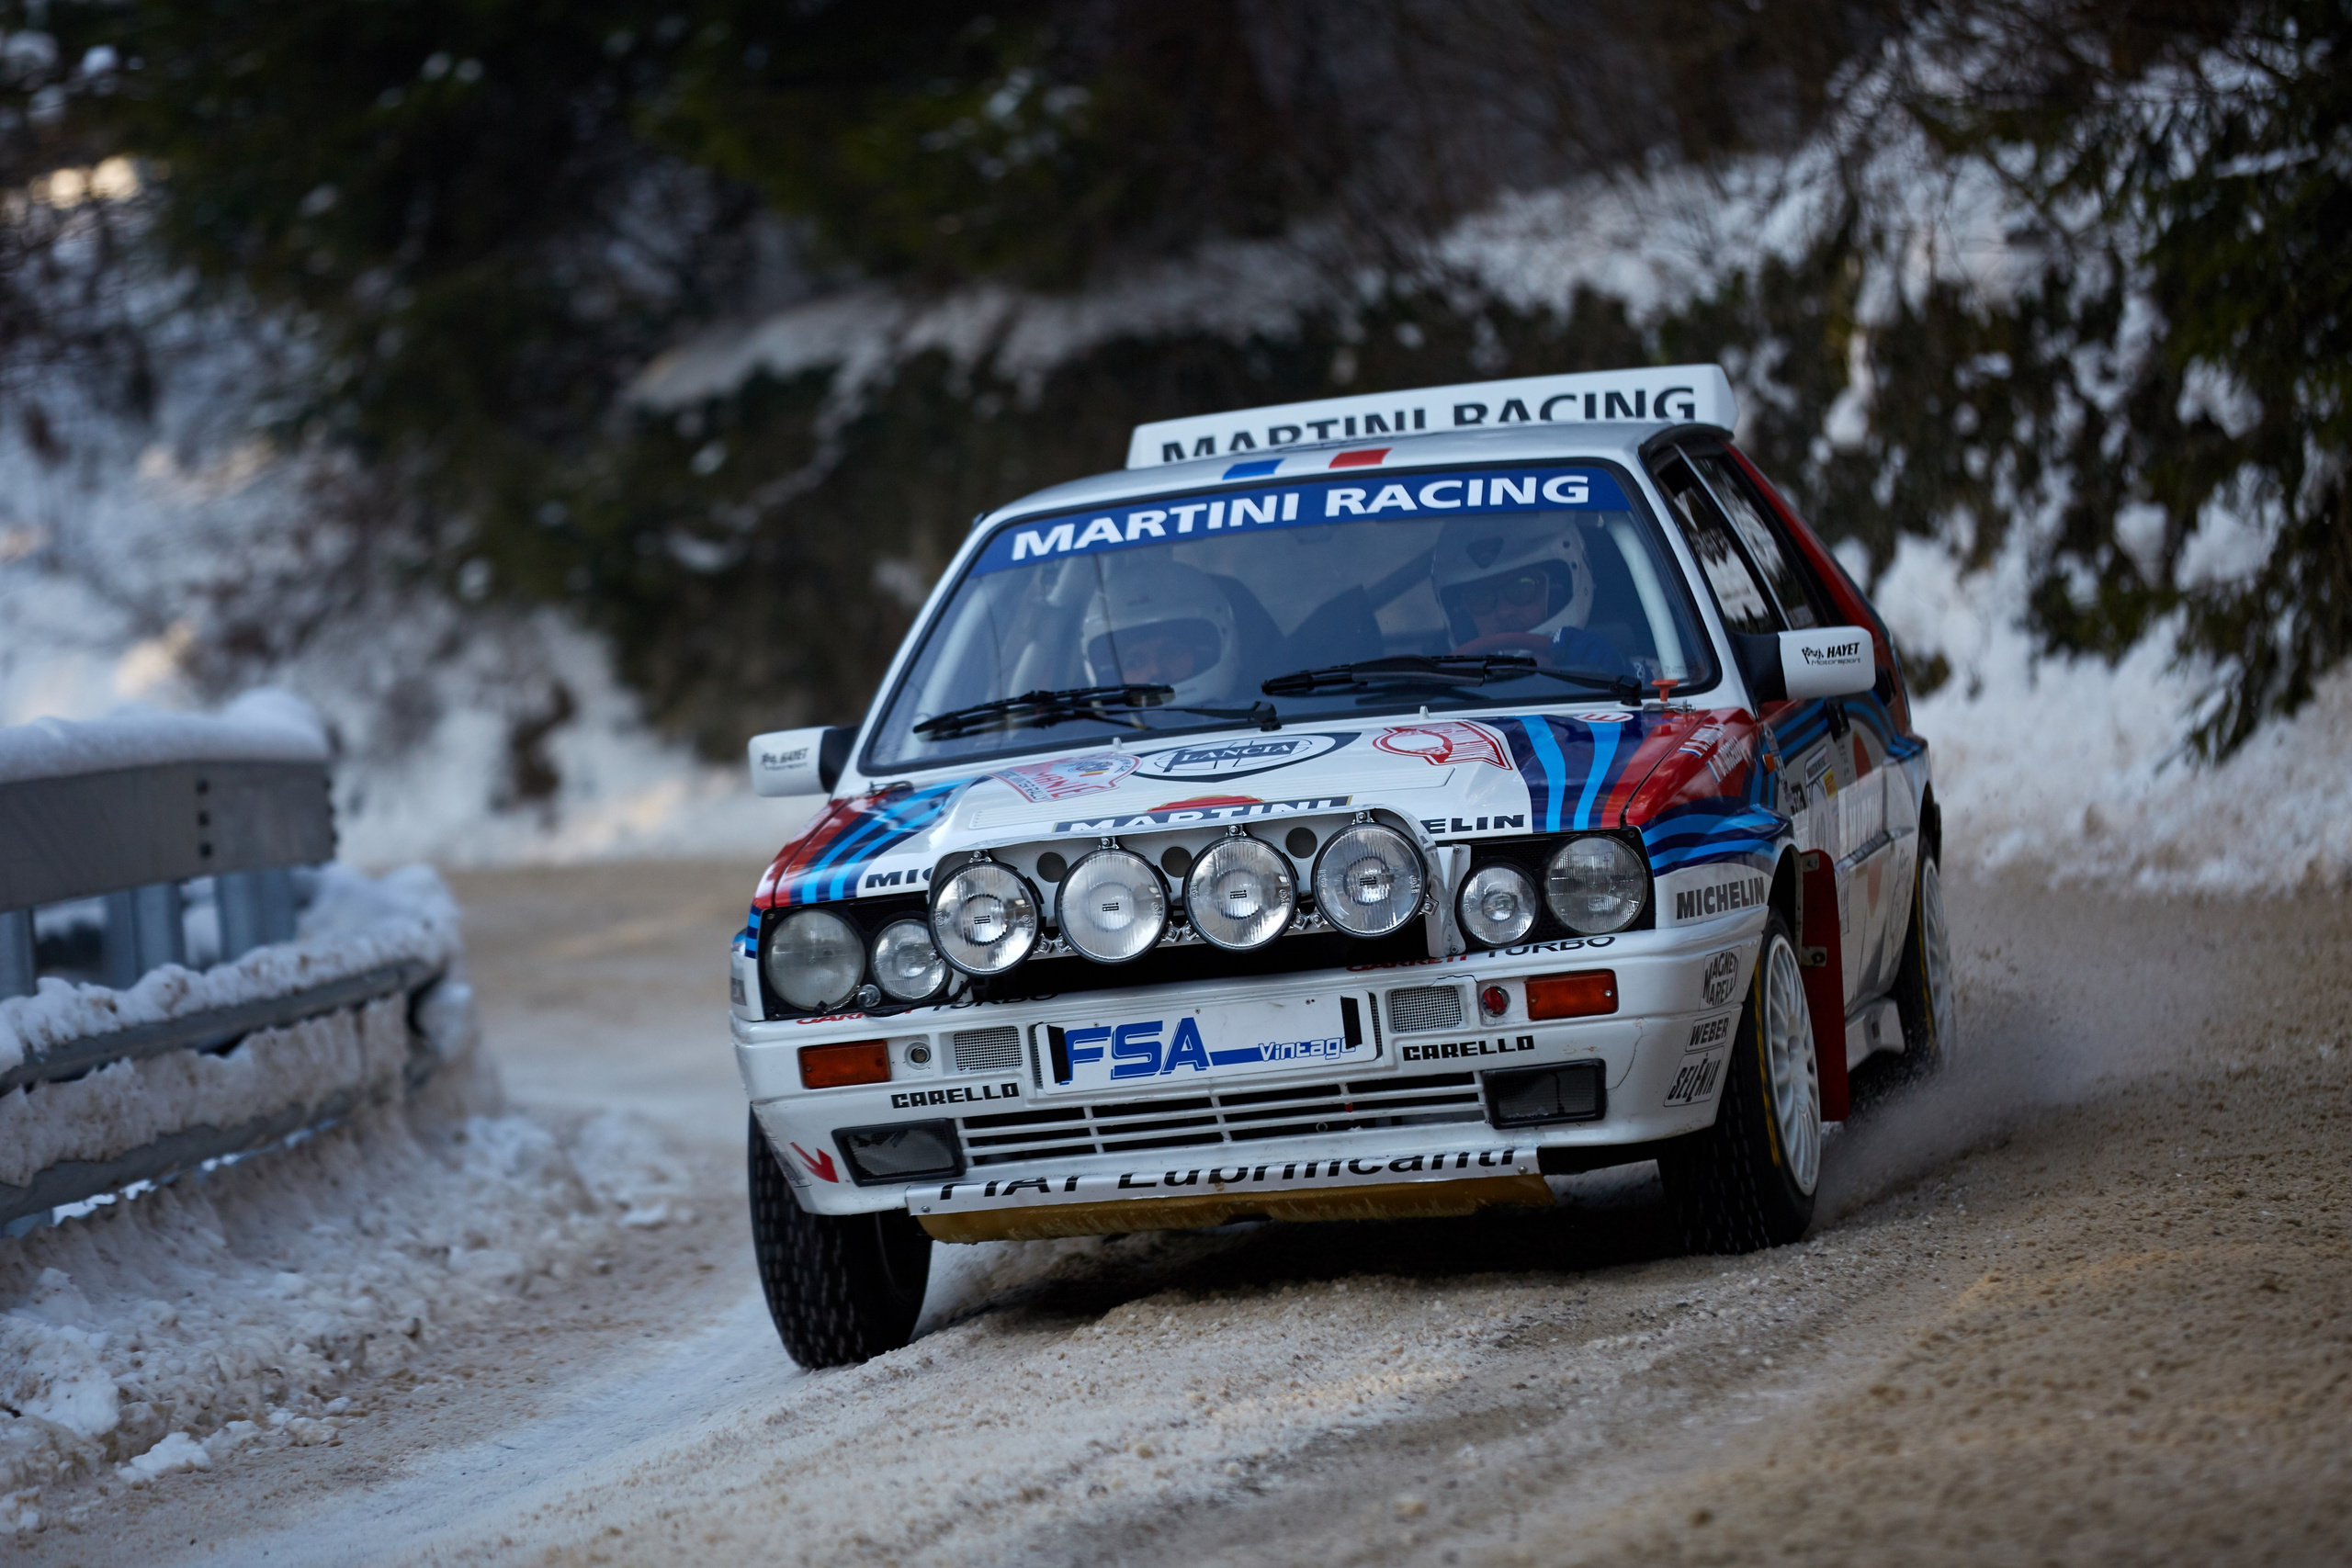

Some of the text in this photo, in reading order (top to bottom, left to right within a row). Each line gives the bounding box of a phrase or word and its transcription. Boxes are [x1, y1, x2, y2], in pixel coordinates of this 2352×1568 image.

[1012, 476, 1589, 560] MARTINI RACING
[1827, 642, 1860, 659] HAYET
[1182, 743, 1292, 762] LANCIA
[1677, 876, 1766, 919] MICHELIN
[1690, 1017, 1729, 1046] WEBER
[1058, 1017, 1209, 1086] FSA
[1403, 1035, 1535, 1061] CARELLO
[891, 1082, 1020, 1110] CARELLO
